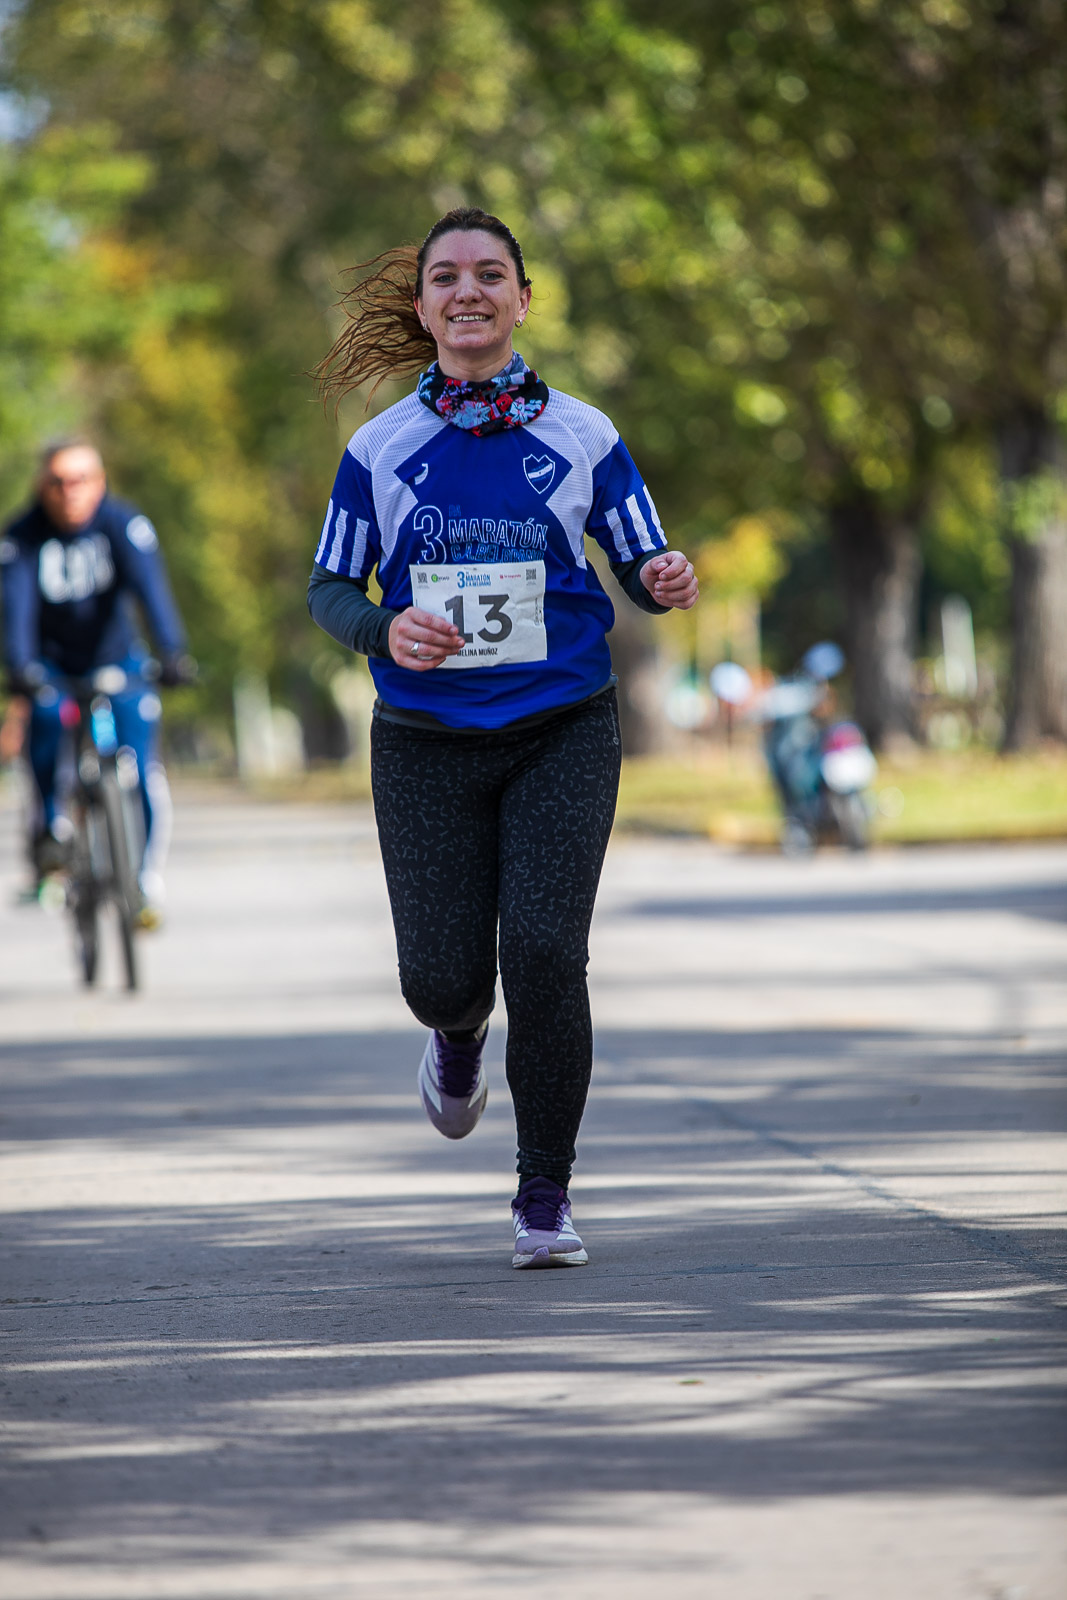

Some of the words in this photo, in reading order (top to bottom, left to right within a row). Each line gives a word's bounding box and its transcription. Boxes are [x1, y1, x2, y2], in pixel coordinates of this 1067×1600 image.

[413, 505, 447, 565] 3
[448, 517, 549, 551] MARATÓN
[457, 571, 466, 589] 3
[444, 593, 513, 643] 13
[478, 646, 498, 656] MUÑOZ
